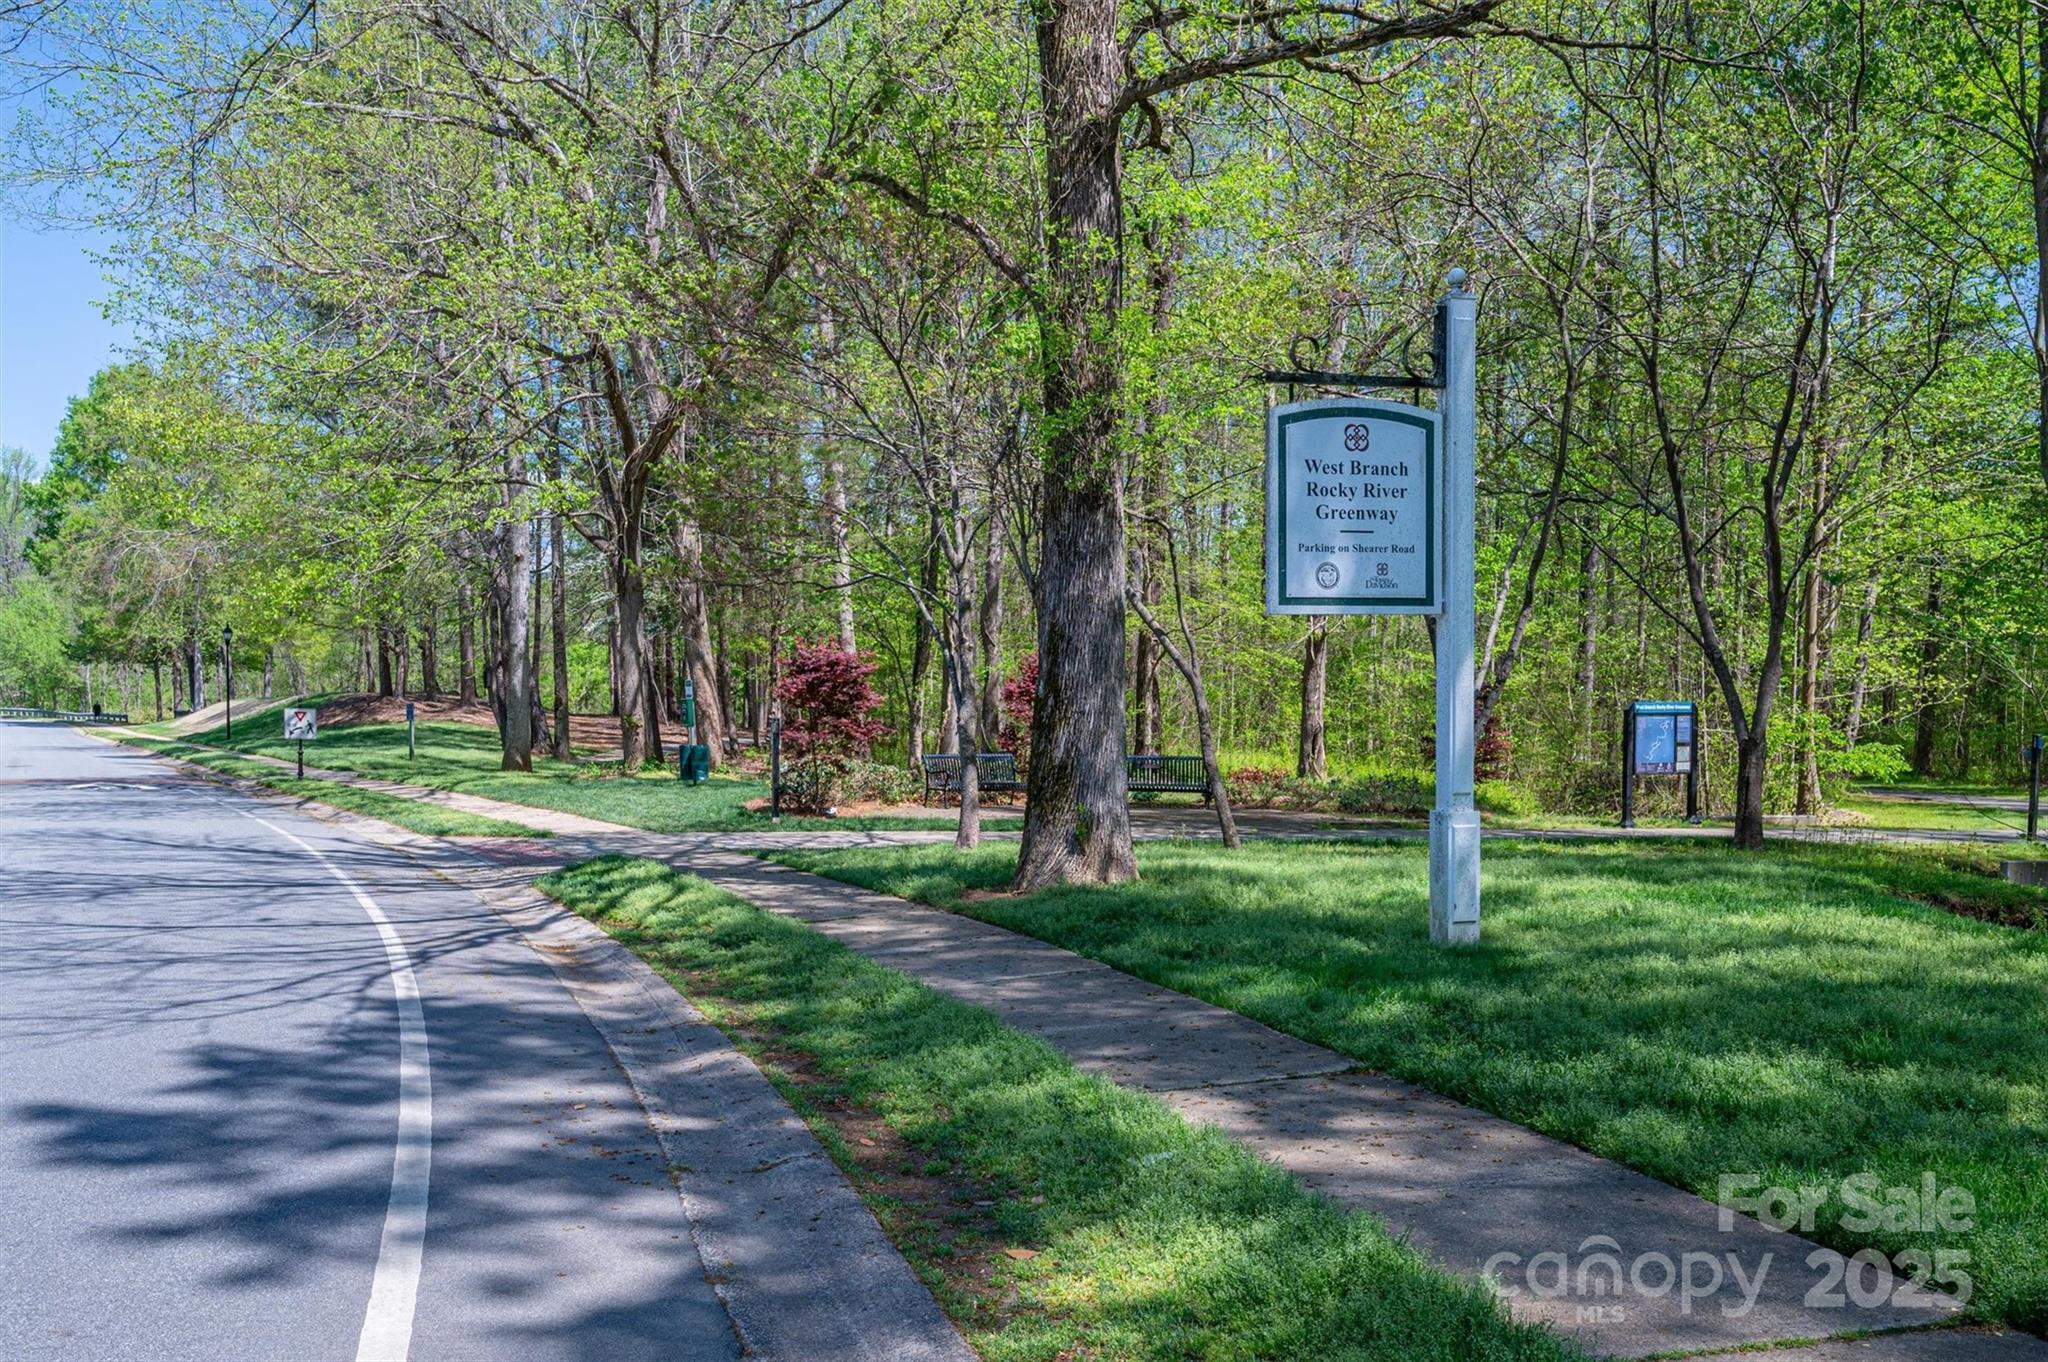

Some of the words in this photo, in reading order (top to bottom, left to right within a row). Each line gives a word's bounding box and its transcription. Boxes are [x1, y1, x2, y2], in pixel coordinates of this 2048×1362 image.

[1305, 459, 1344, 475] West
[1350, 460, 1409, 477] Branch
[1306, 482, 1357, 502] Rocky
[1363, 483, 1408, 499] River
[1316, 504, 1398, 525] Greenway
[1298, 543, 1336, 554] Parking
[1352, 544, 1389, 553] Shearer
[1391, 544, 1415, 554] Road
